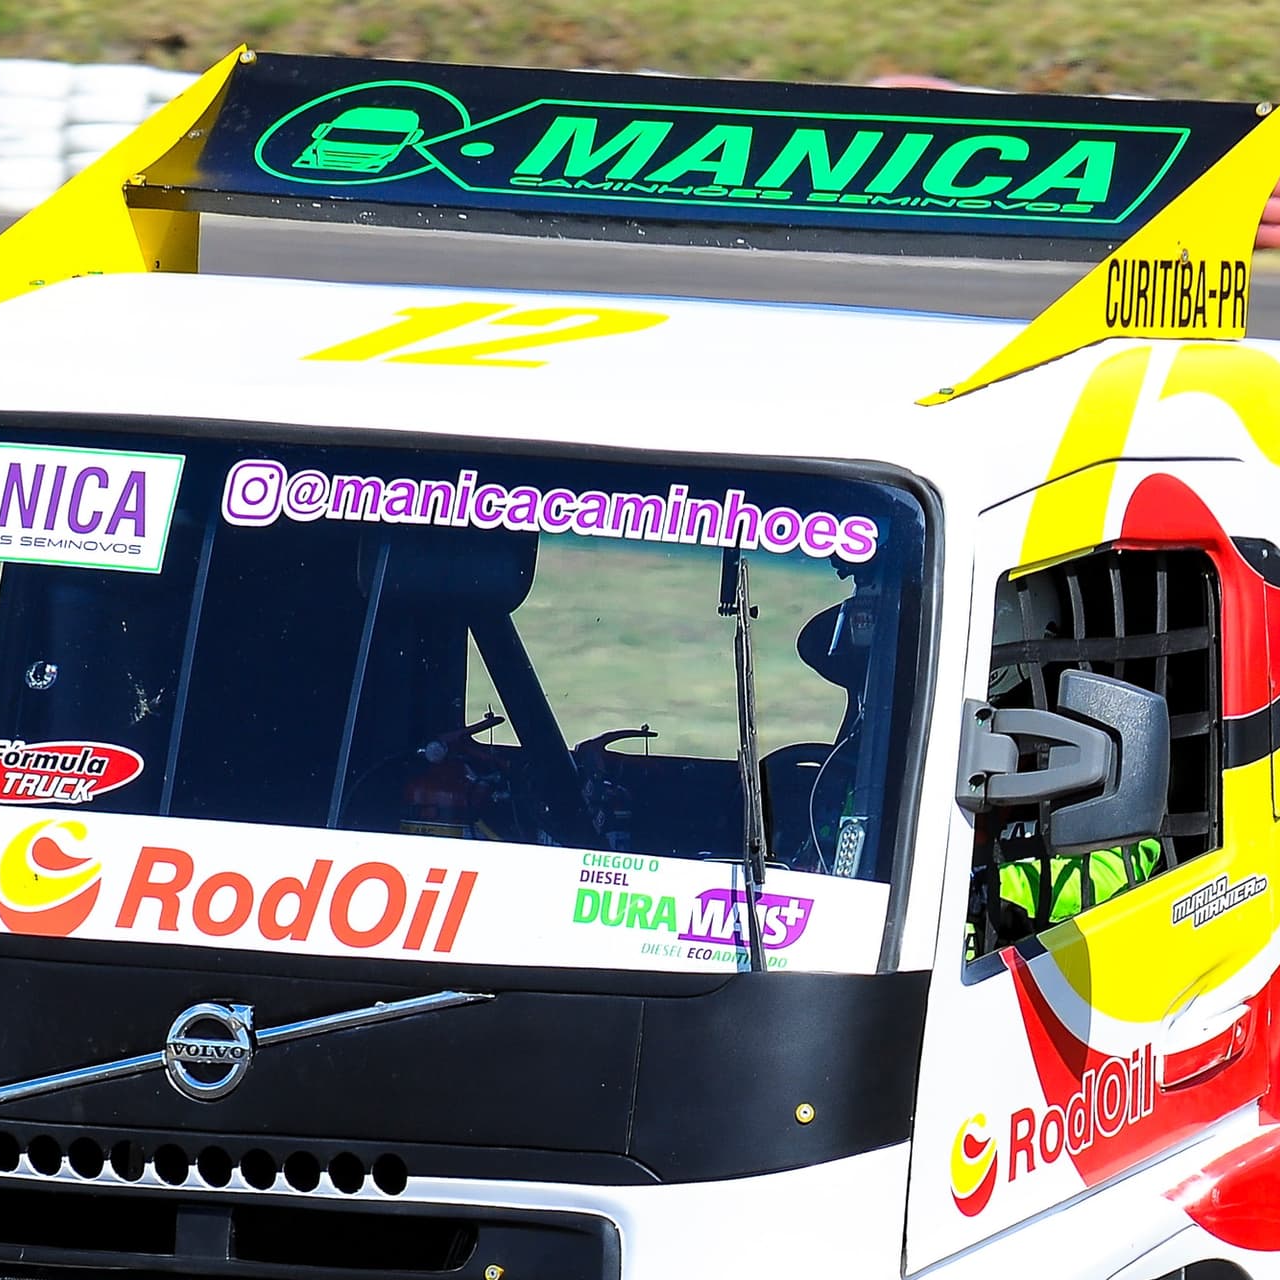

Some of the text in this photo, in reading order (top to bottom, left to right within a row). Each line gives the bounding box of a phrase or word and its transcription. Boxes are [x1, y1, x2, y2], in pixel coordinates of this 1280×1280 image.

[514, 116, 1116, 203] MANICA
[510, 177, 1094, 213] CAMINHÕES SEMINOVOS
[1105, 259, 1247, 329] CURITIBA-PR
[298, 302, 671, 368] 12
[286, 470, 878, 558] @manicacaminhoes
[20, 536, 142, 554] SEMINOVOS
[2, 772, 97, 800] TRUCK
[580, 869, 629, 886] DIESEL
[582, 853, 659, 873] CHEGOU O
[115, 846, 478, 953] RodOil
[573, 888, 677, 932] DURA
[1172, 876, 1228, 924] MURILO
[641, 942, 788, 969] DIESEL ECOADITIDO
[168, 1043, 245, 1059] VOLVO
[1008, 1043, 1154, 1183] RodOil
